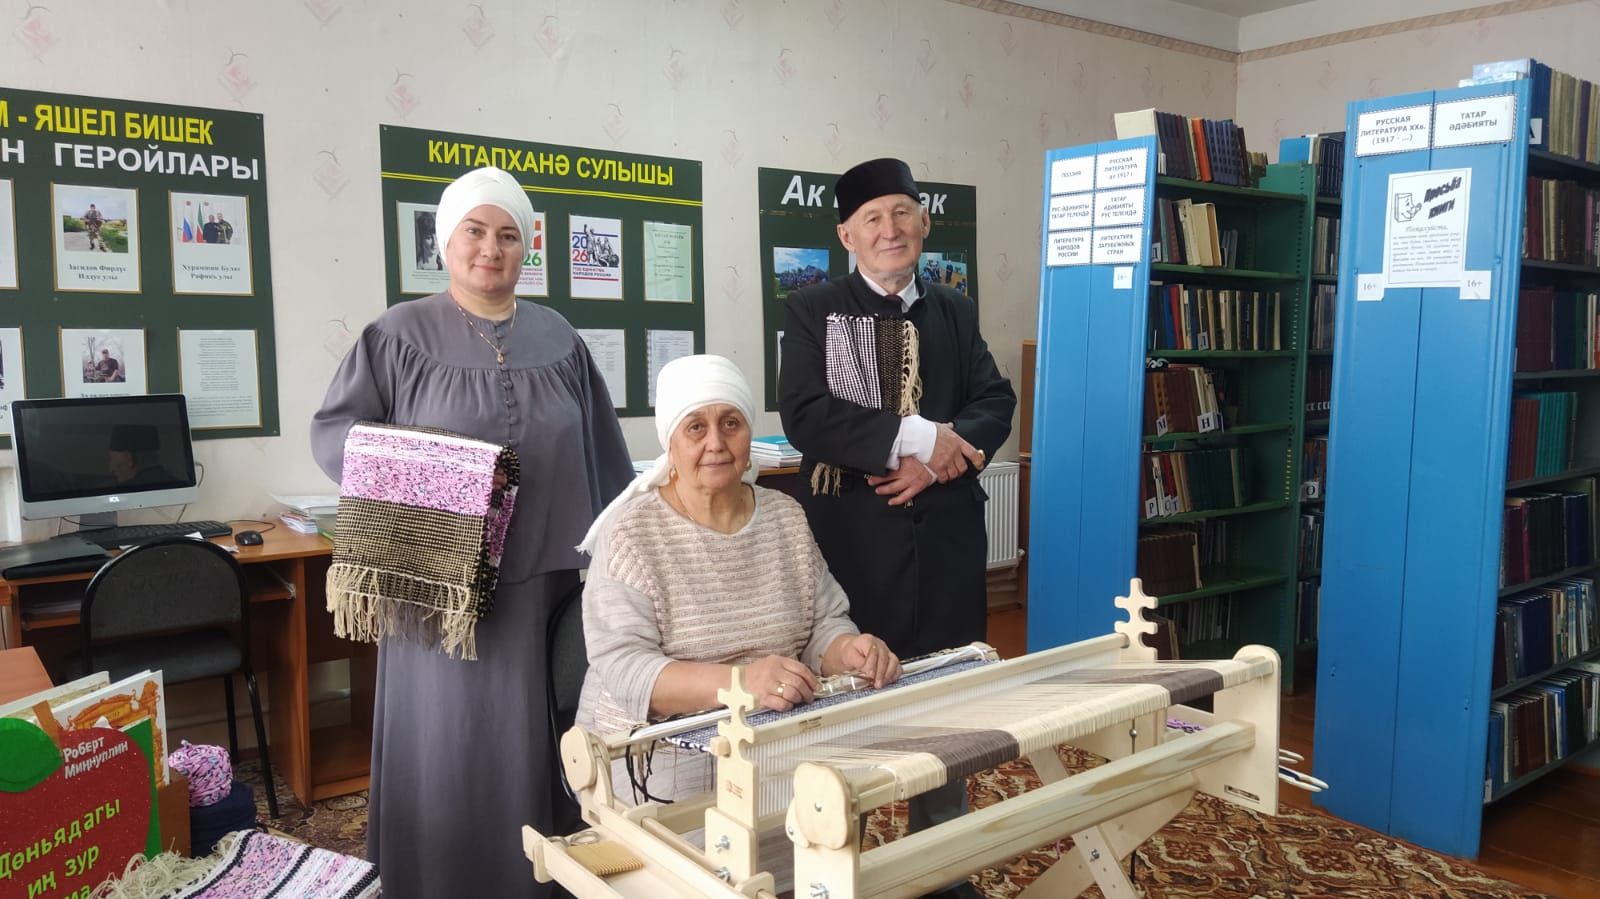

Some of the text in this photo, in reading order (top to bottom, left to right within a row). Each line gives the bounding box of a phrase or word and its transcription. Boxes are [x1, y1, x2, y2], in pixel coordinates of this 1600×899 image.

[1375, 115, 1412, 126] РУССКАЯ
[1460, 110, 1487, 120] ТАТАР
[34, 104, 117, 137] ЯШЕЛ
[124, 111, 214, 146] БИШЕК
[1448, 119, 1498, 132] ӘДӘБИЯТЫ
[1360, 125, 1408, 137] ЛИТЕРАТУРА
[54, 141, 259, 181] ГЕРОЙЛАРЫ
[427, 139, 674, 187] КИТАПХАНӘ СУЛЫШЫ
[1108, 156, 1133, 165] РУССКАЯ
[1104, 163, 1138, 172] ЛИТЕРАТУРА
[780, 174, 826, 208] Ак
[1053, 236, 1085, 245] ЛИТЕРАТУРА
[1101, 233, 1133, 241] ЛИТЕРАТУРА
[1097, 241, 1136, 249] ЗАРУБЕЖНЫХ
[1363, 283, 1377, 291] 16+
[1467, 279, 1484, 288] 16+
[1202, 416, 1211, 429] Н
[63, 736, 105, 763] Роберт
[64, 845, 100, 877] зур
